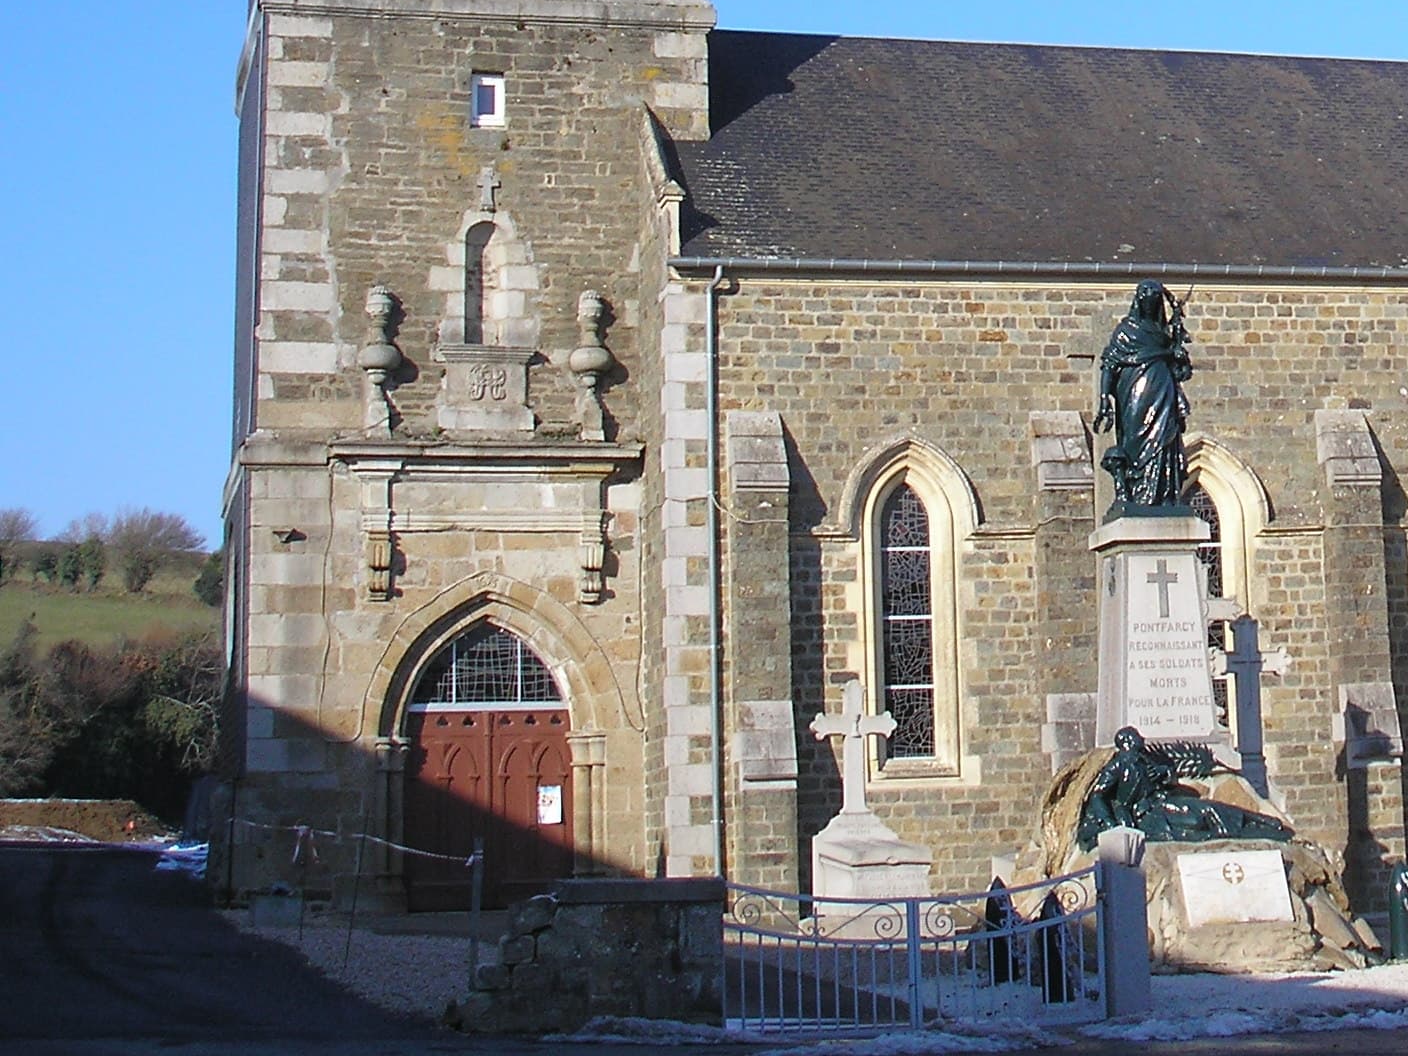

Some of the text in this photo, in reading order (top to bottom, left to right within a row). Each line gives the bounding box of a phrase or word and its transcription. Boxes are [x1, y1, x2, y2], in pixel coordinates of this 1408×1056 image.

[1133, 622, 1196, 633] PONTFARCY
[1129, 641, 1203, 651] RECONNAISSANT
[1138, 659, 1157, 670] SES
[1159, 658, 1203, 669] SOLDATS
[1150, 677, 1187, 688] MORTS
[1128, 695, 1211, 709] POUR LA FRANCE
[1139, 714, 1161, 727] 1914
[1179, 714, 1200, 725] 1918
